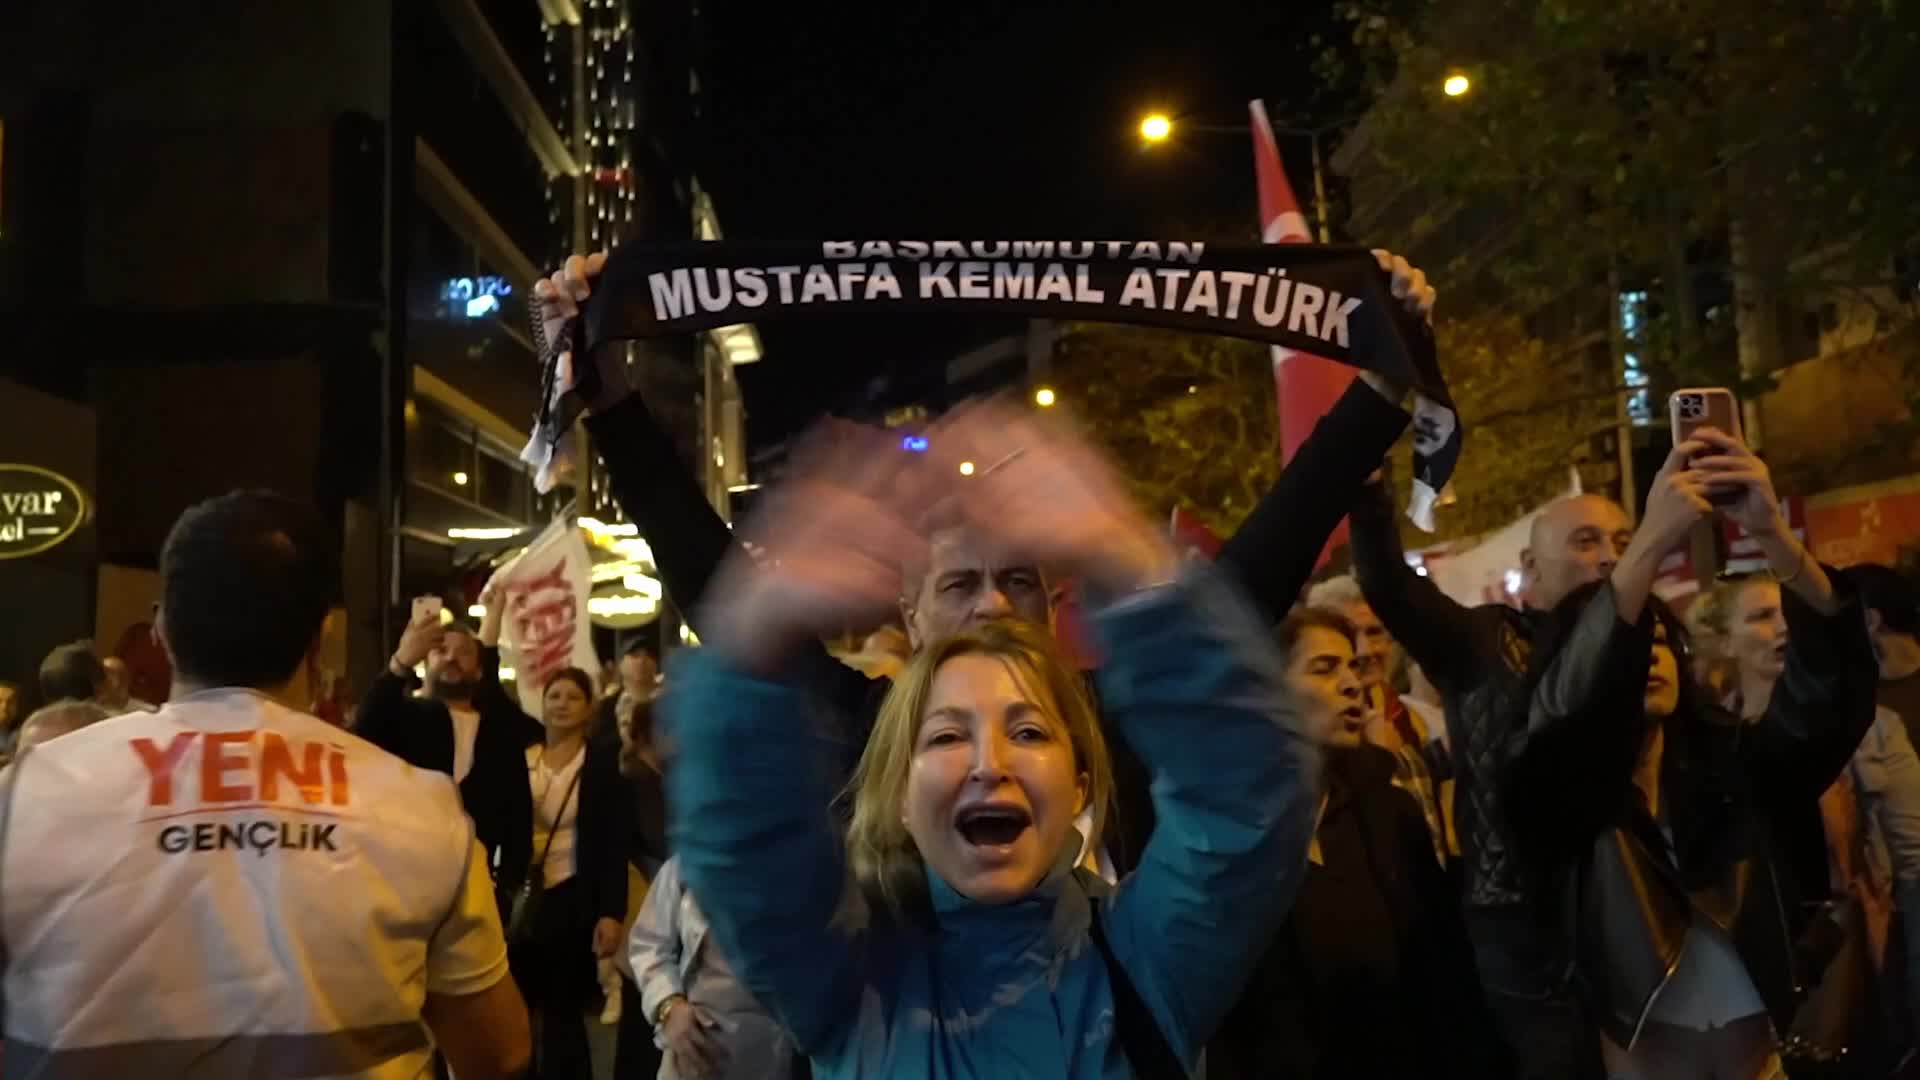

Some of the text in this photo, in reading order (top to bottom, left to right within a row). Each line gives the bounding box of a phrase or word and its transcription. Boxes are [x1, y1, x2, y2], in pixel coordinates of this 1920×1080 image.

[648, 262, 1363, 348] MUSTAFA KEMAL ATATÜRK
[0, 516, 24, 541] el
